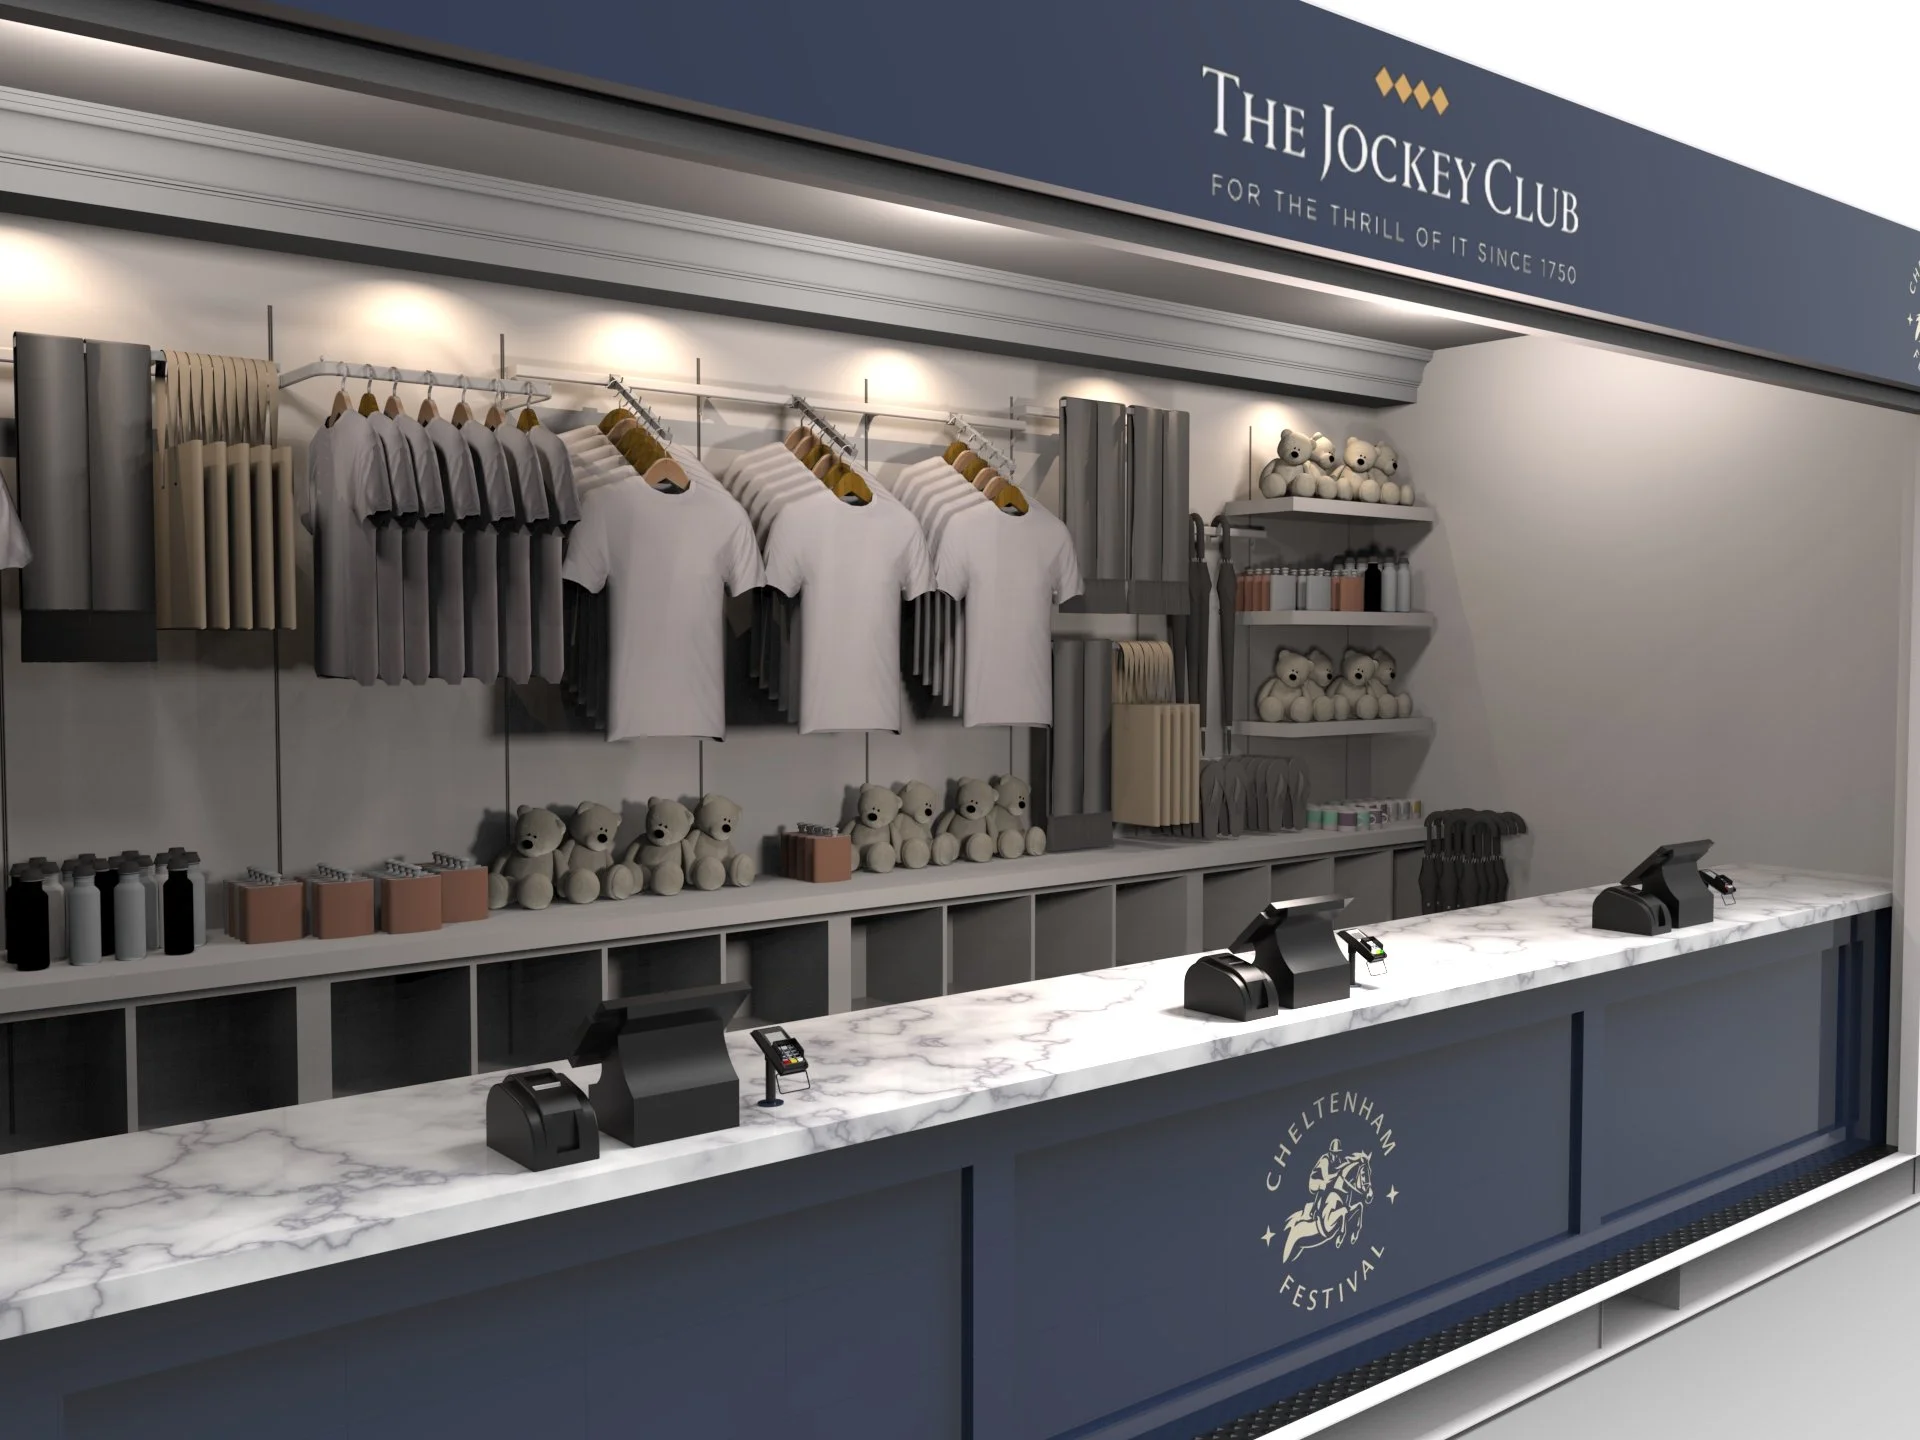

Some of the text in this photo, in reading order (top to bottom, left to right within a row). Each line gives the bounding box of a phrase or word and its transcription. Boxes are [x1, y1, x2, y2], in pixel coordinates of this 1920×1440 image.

[1202, 65, 1579, 234] THE JOCKEY CLUB
[1211, 173, 1577, 286] FOR THE THRILL OF IT SINCE 1750
[1266, 1091, 1396, 1192] CHELTENHAM
[1279, 1245, 1385, 1311] FESTIVAL
